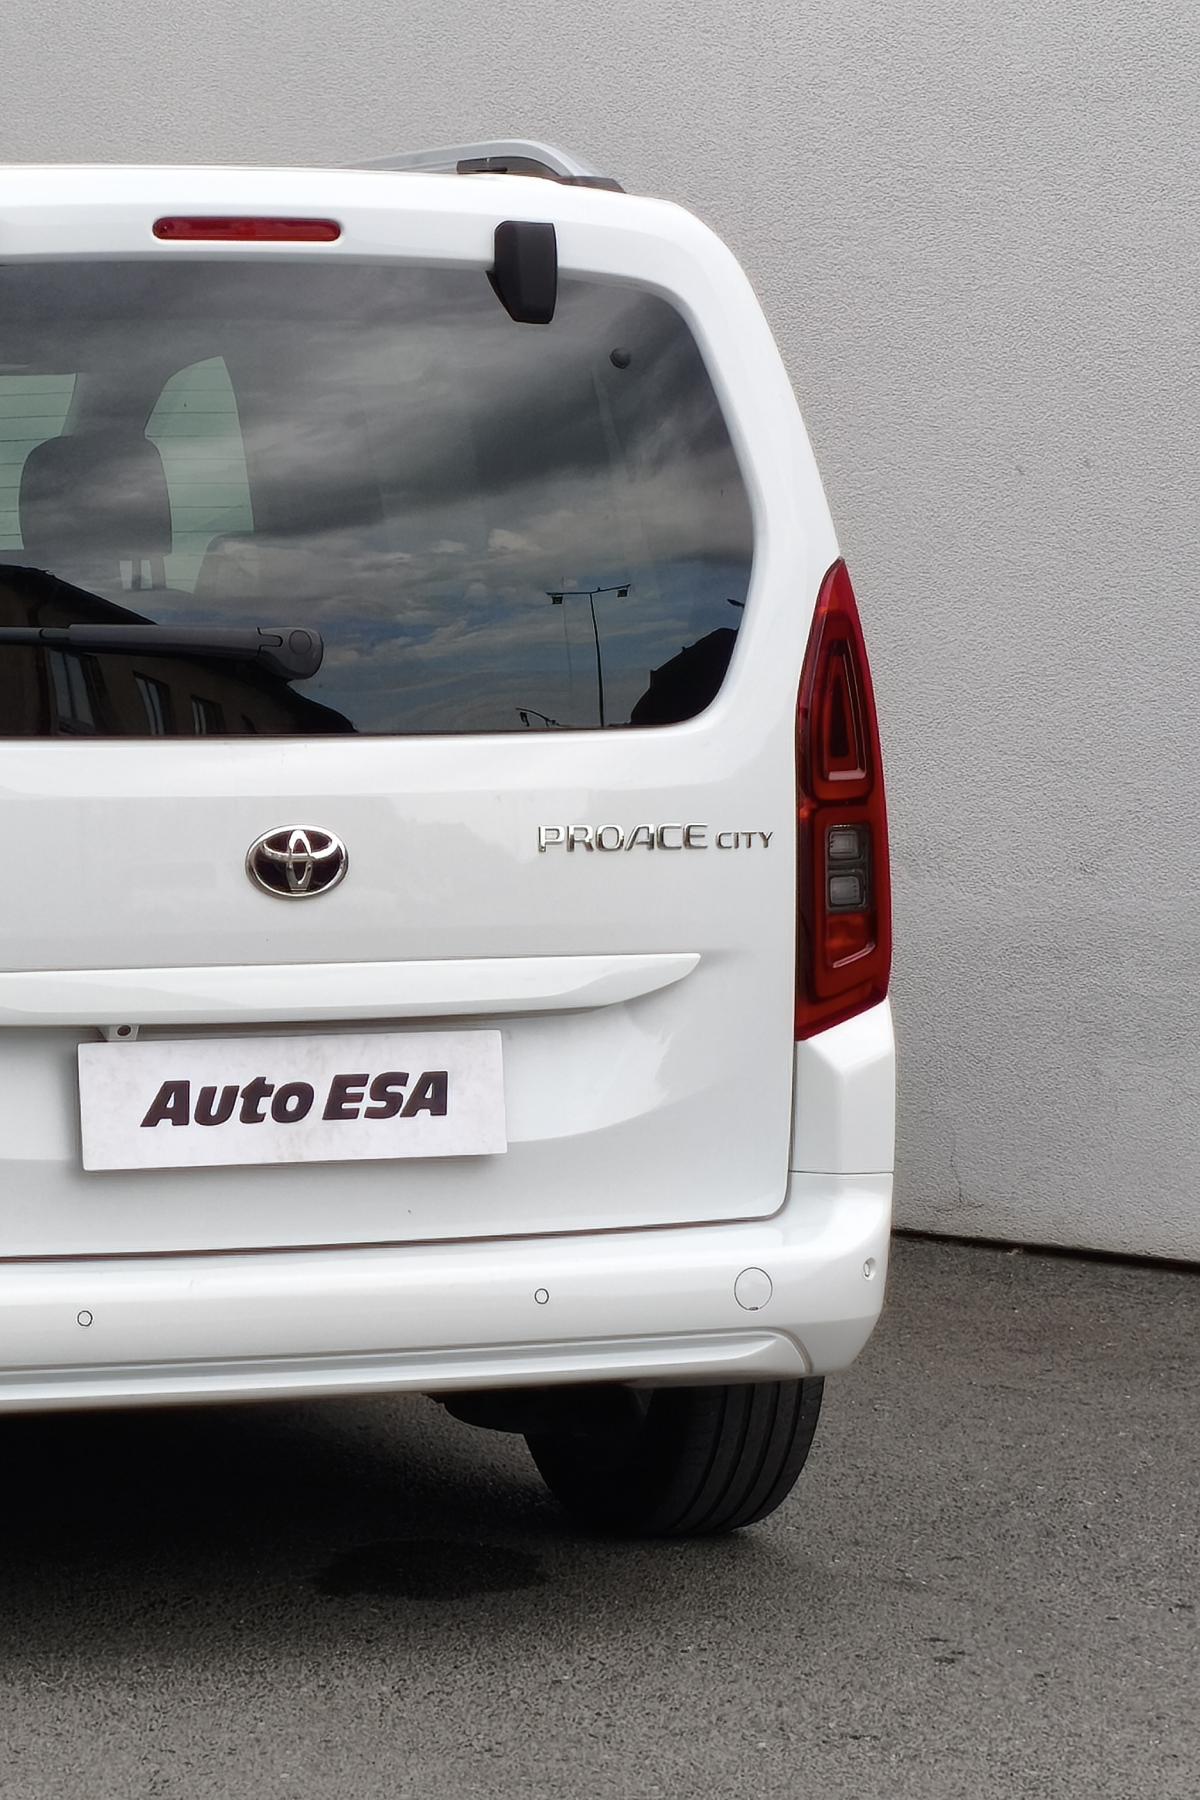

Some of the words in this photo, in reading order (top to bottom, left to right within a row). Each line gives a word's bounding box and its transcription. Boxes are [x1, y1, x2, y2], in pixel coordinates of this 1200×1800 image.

[537, 823, 709, 852] PROACE
[715, 831, 774, 849] CITY
[139, 1076, 315, 1128] Auto
[321, 1070, 449, 1121] ESA
